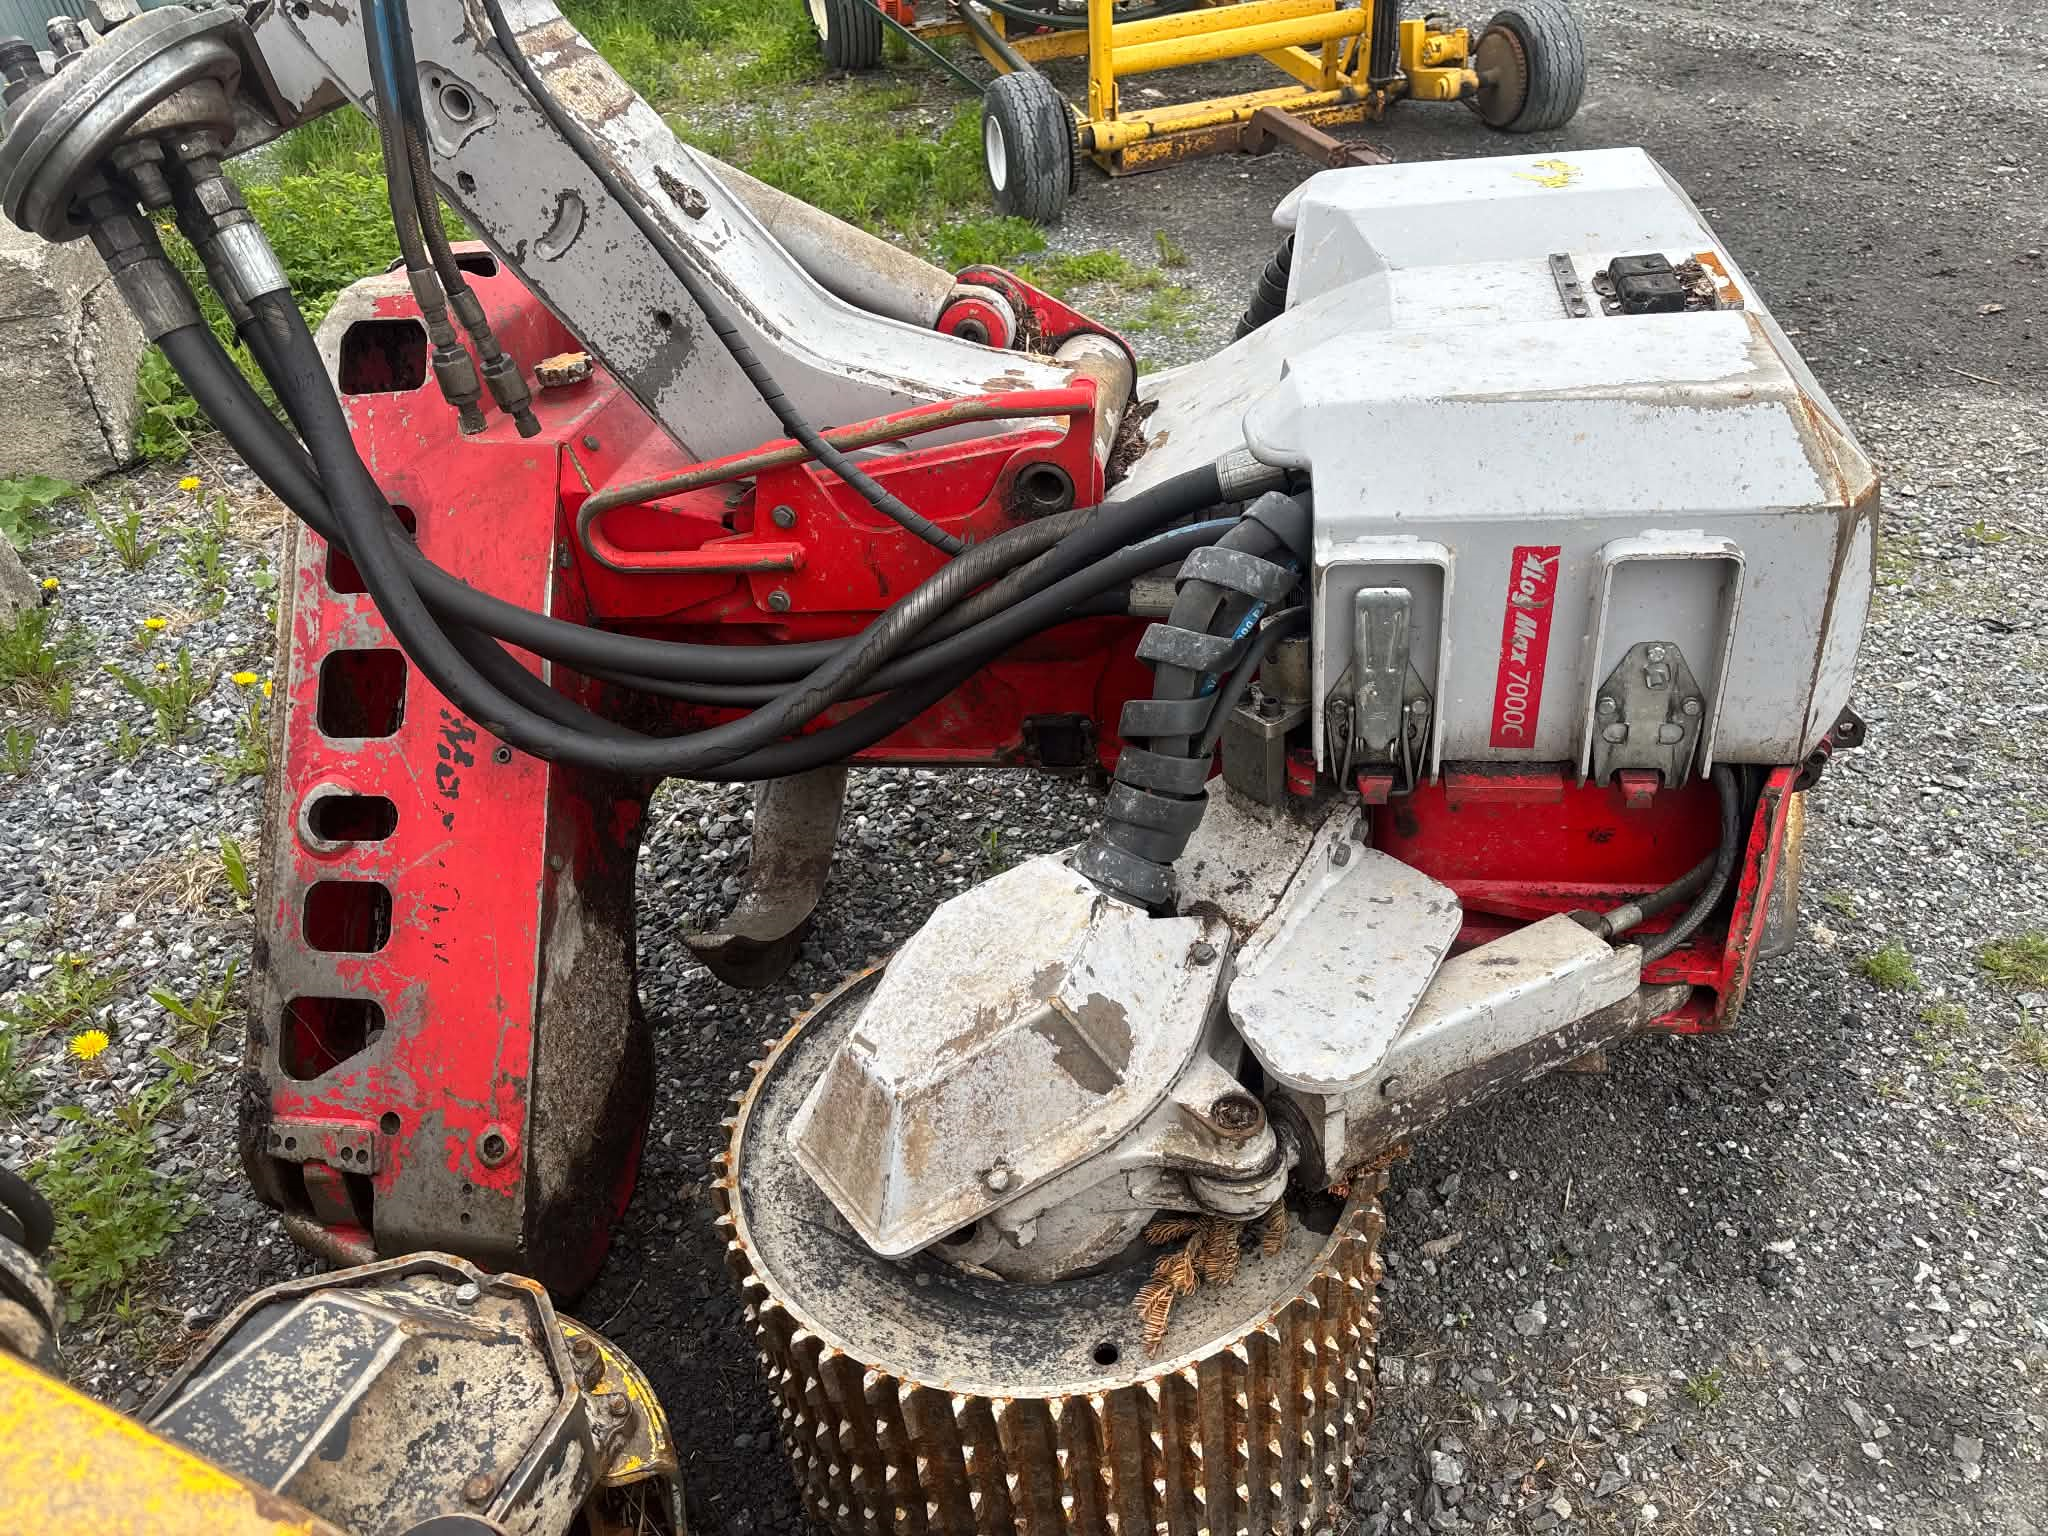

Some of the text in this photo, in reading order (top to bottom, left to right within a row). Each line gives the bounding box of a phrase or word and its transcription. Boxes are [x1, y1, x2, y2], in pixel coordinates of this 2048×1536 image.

[1501, 566, 1546, 737] Log Max 7000C
